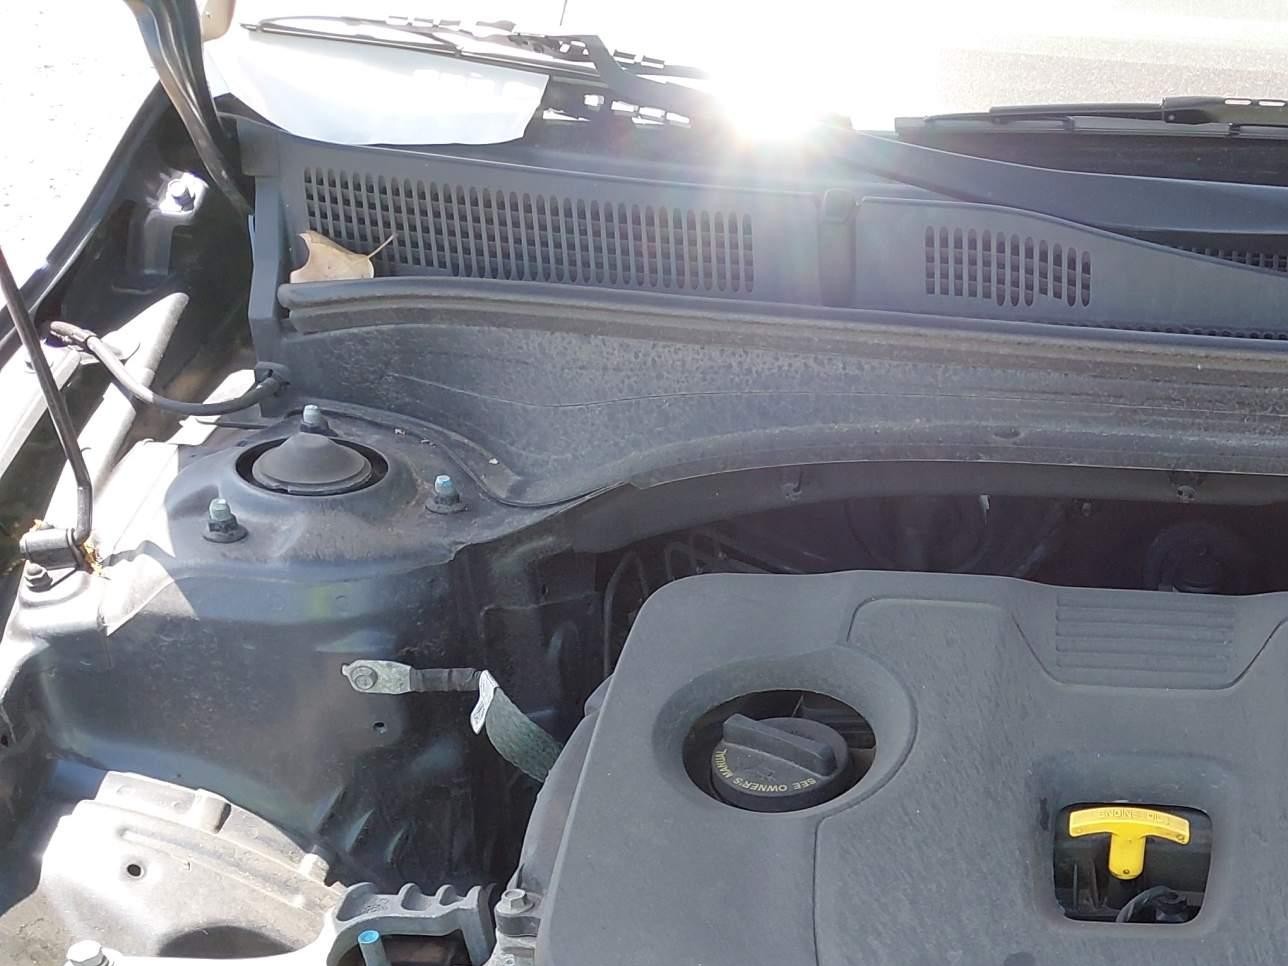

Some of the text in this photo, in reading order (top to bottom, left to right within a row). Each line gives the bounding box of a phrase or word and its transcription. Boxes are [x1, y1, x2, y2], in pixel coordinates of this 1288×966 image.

[714, 749, 816, 792] SEE OWNER'S MANUAL
